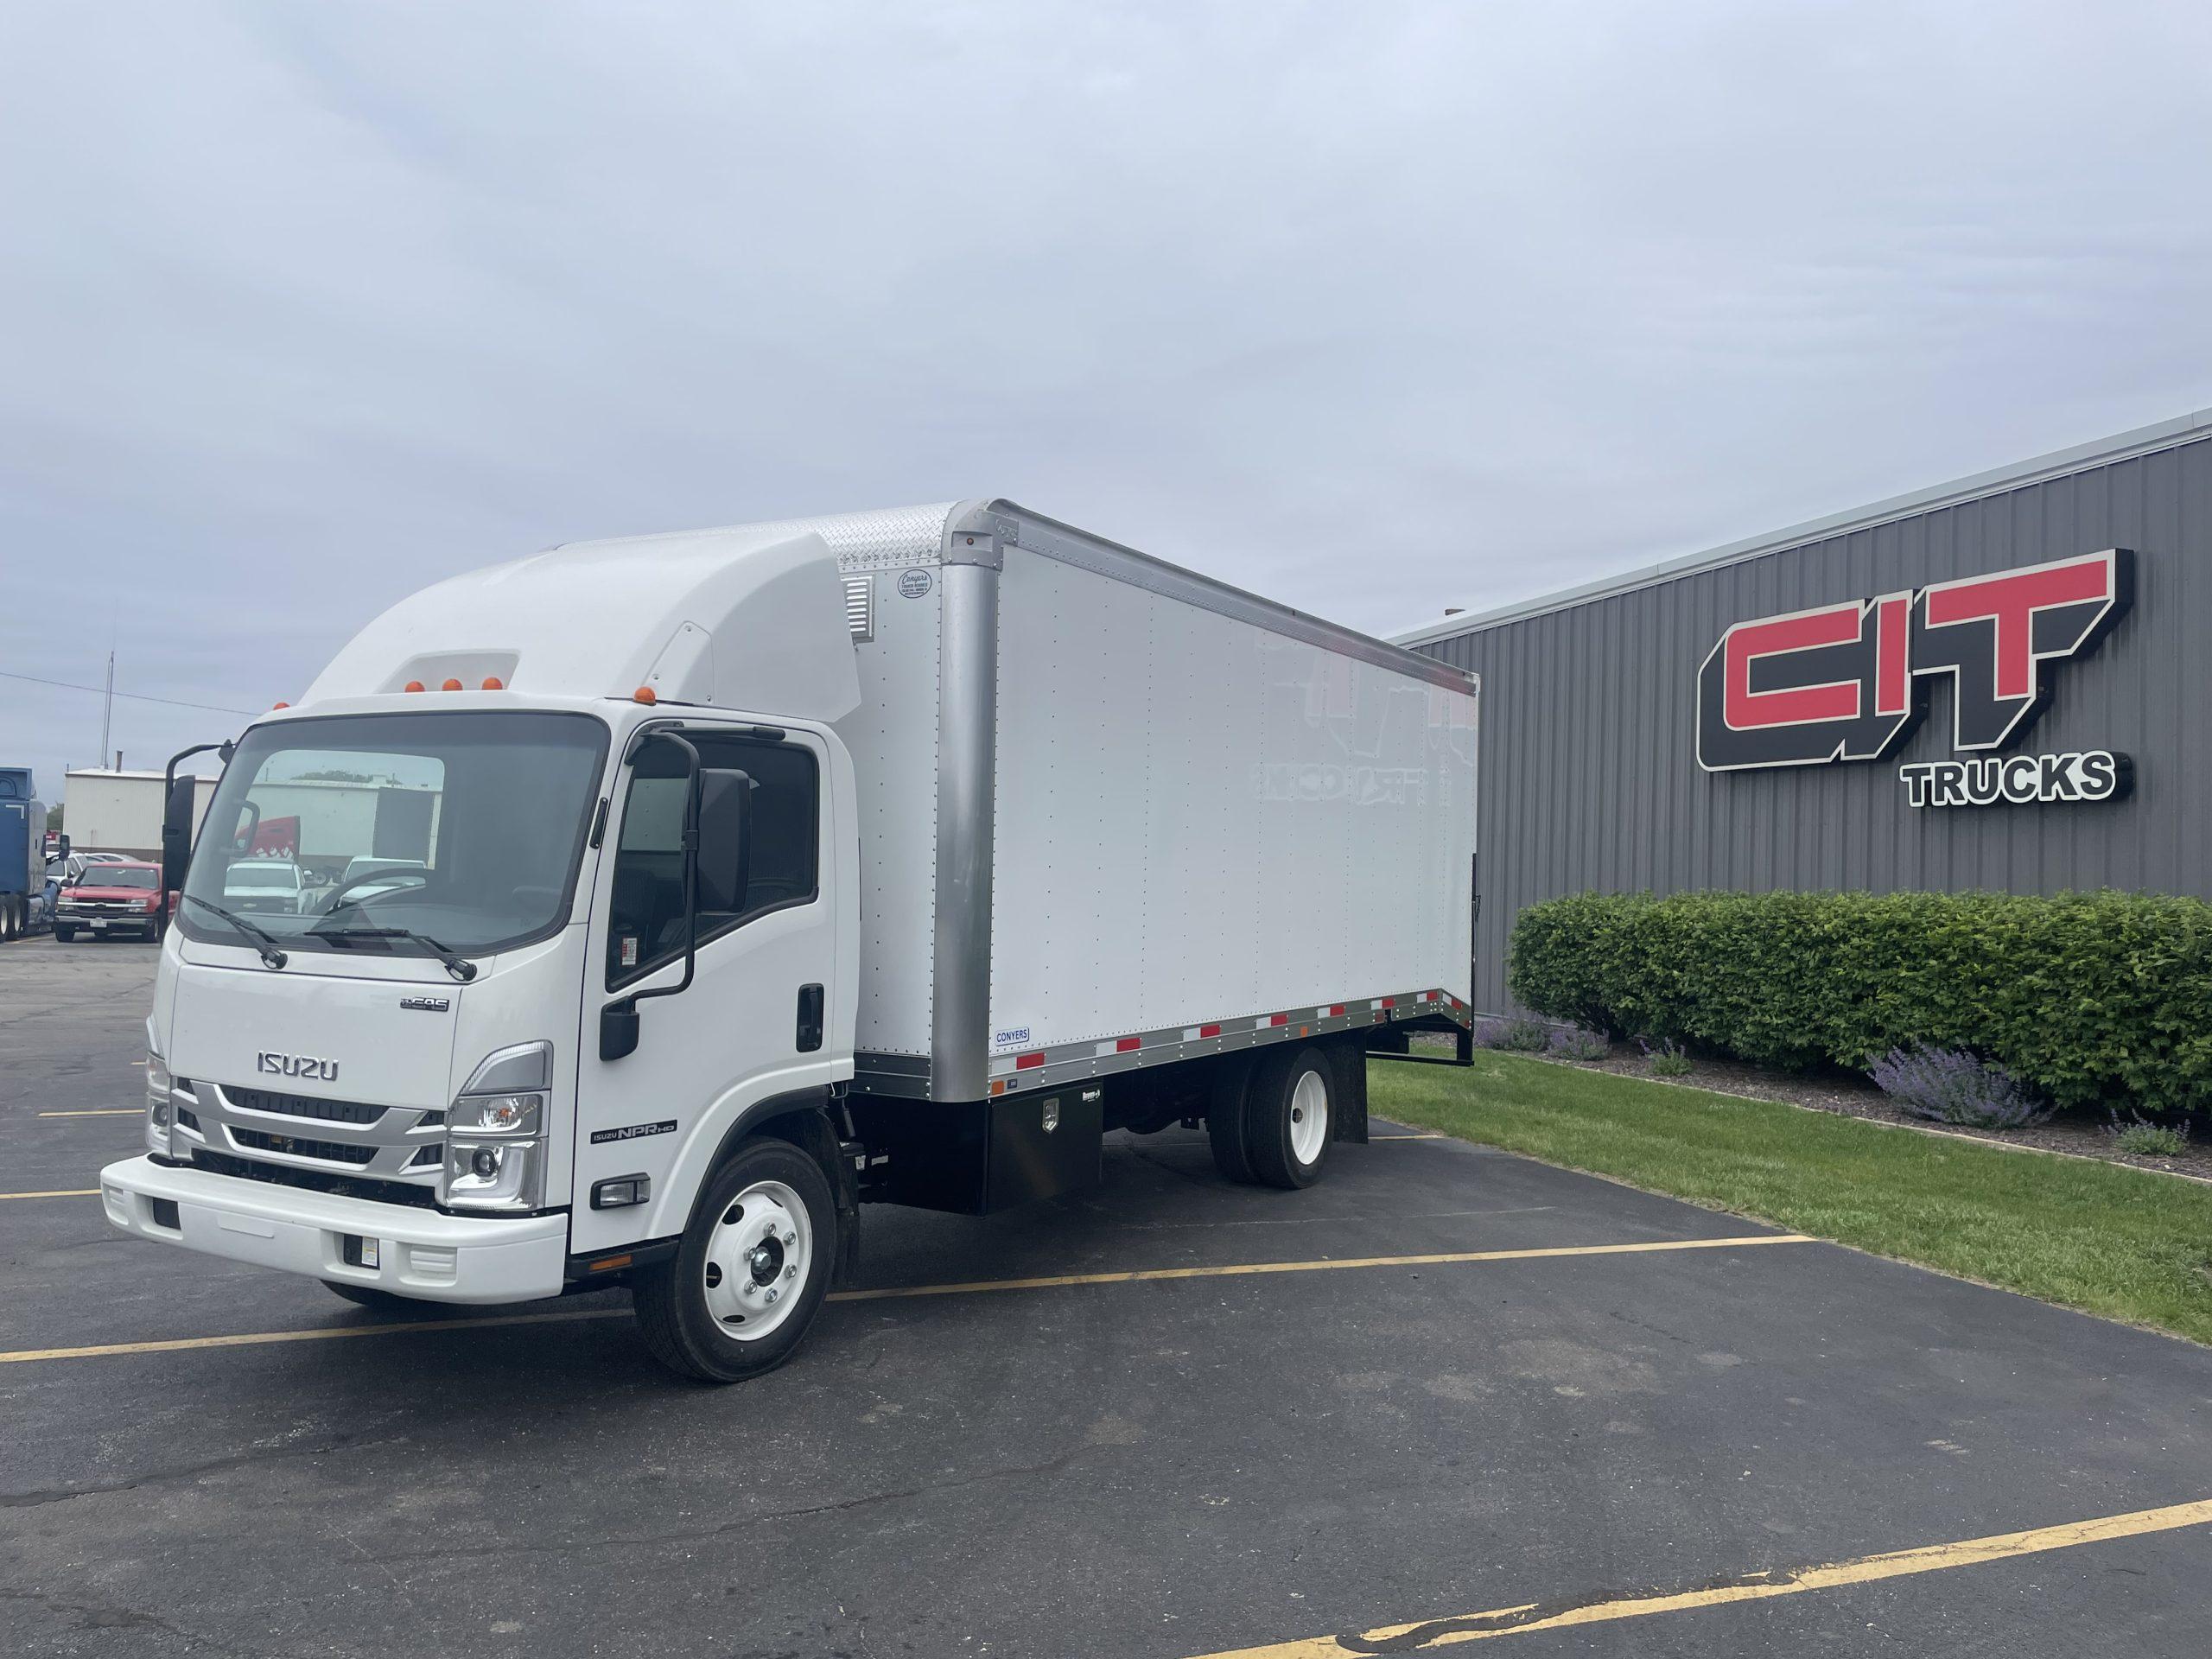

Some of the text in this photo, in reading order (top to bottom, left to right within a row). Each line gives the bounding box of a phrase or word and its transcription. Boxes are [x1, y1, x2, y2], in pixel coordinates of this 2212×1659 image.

[1699, 549, 2118, 769] CIT
[1901, 751, 2115, 806] TRUCKS
[996, 1029, 1027, 1042] CONYERS
[257, 1051, 339, 1081] ISUZU
[594, 1132, 617, 1141] ISUZU
